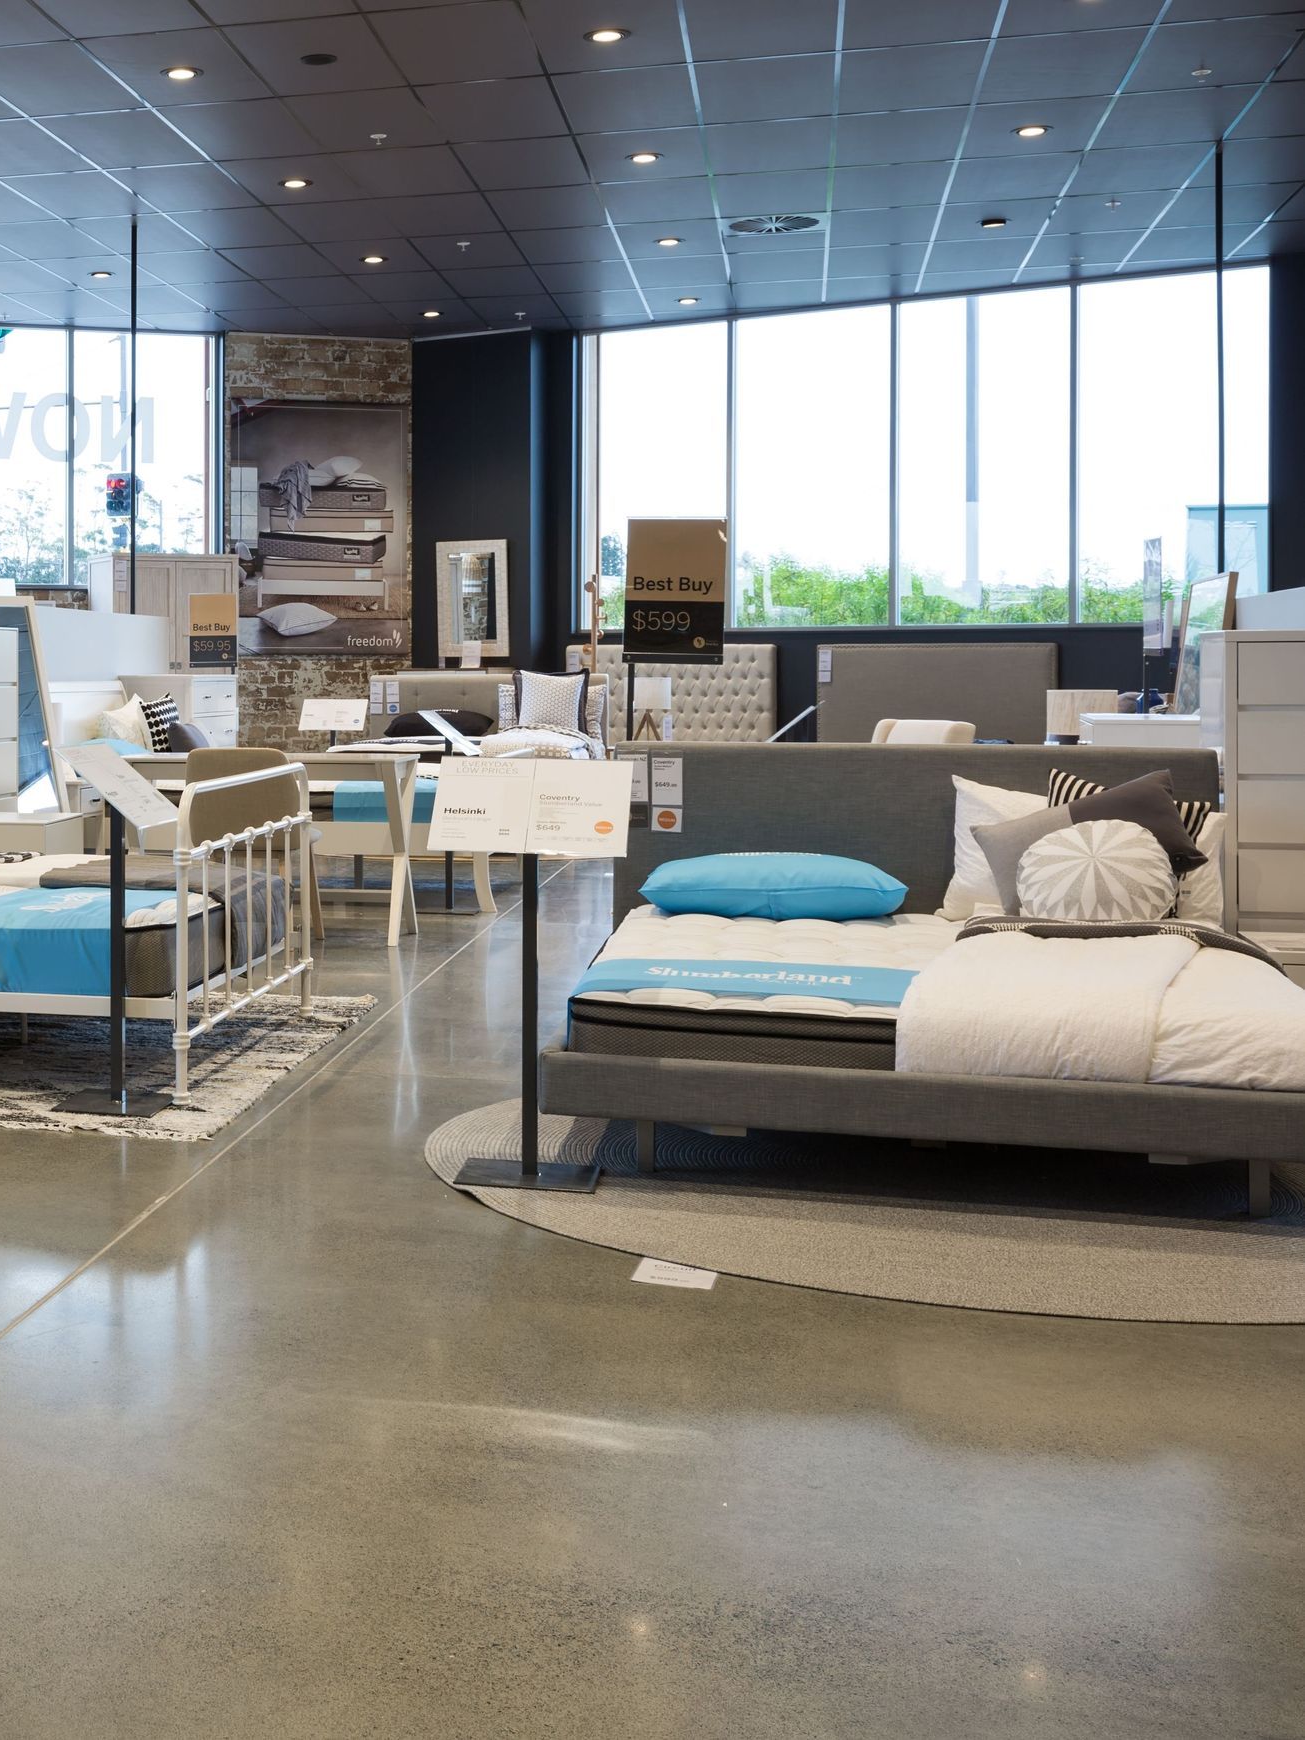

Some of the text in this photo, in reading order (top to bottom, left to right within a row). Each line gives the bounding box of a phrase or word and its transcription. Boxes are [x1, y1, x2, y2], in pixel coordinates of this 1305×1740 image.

[633, 576, 713, 595] Best Buy
[632, 609, 691, 632] $599
[192, 623, 231, 632] Best Buy
[347, 635, 393, 647] freedom
[193, 640, 231, 652] $59.95
[461, 760, 515, 768] EVERYDAY
[481, 767, 519, 775] PRICES
[539, 793, 581, 802] Coventry
[443, 807, 487, 815] Helsinki
[536, 823, 561, 831] $649
[645, 966, 852, 985] Slumberland
